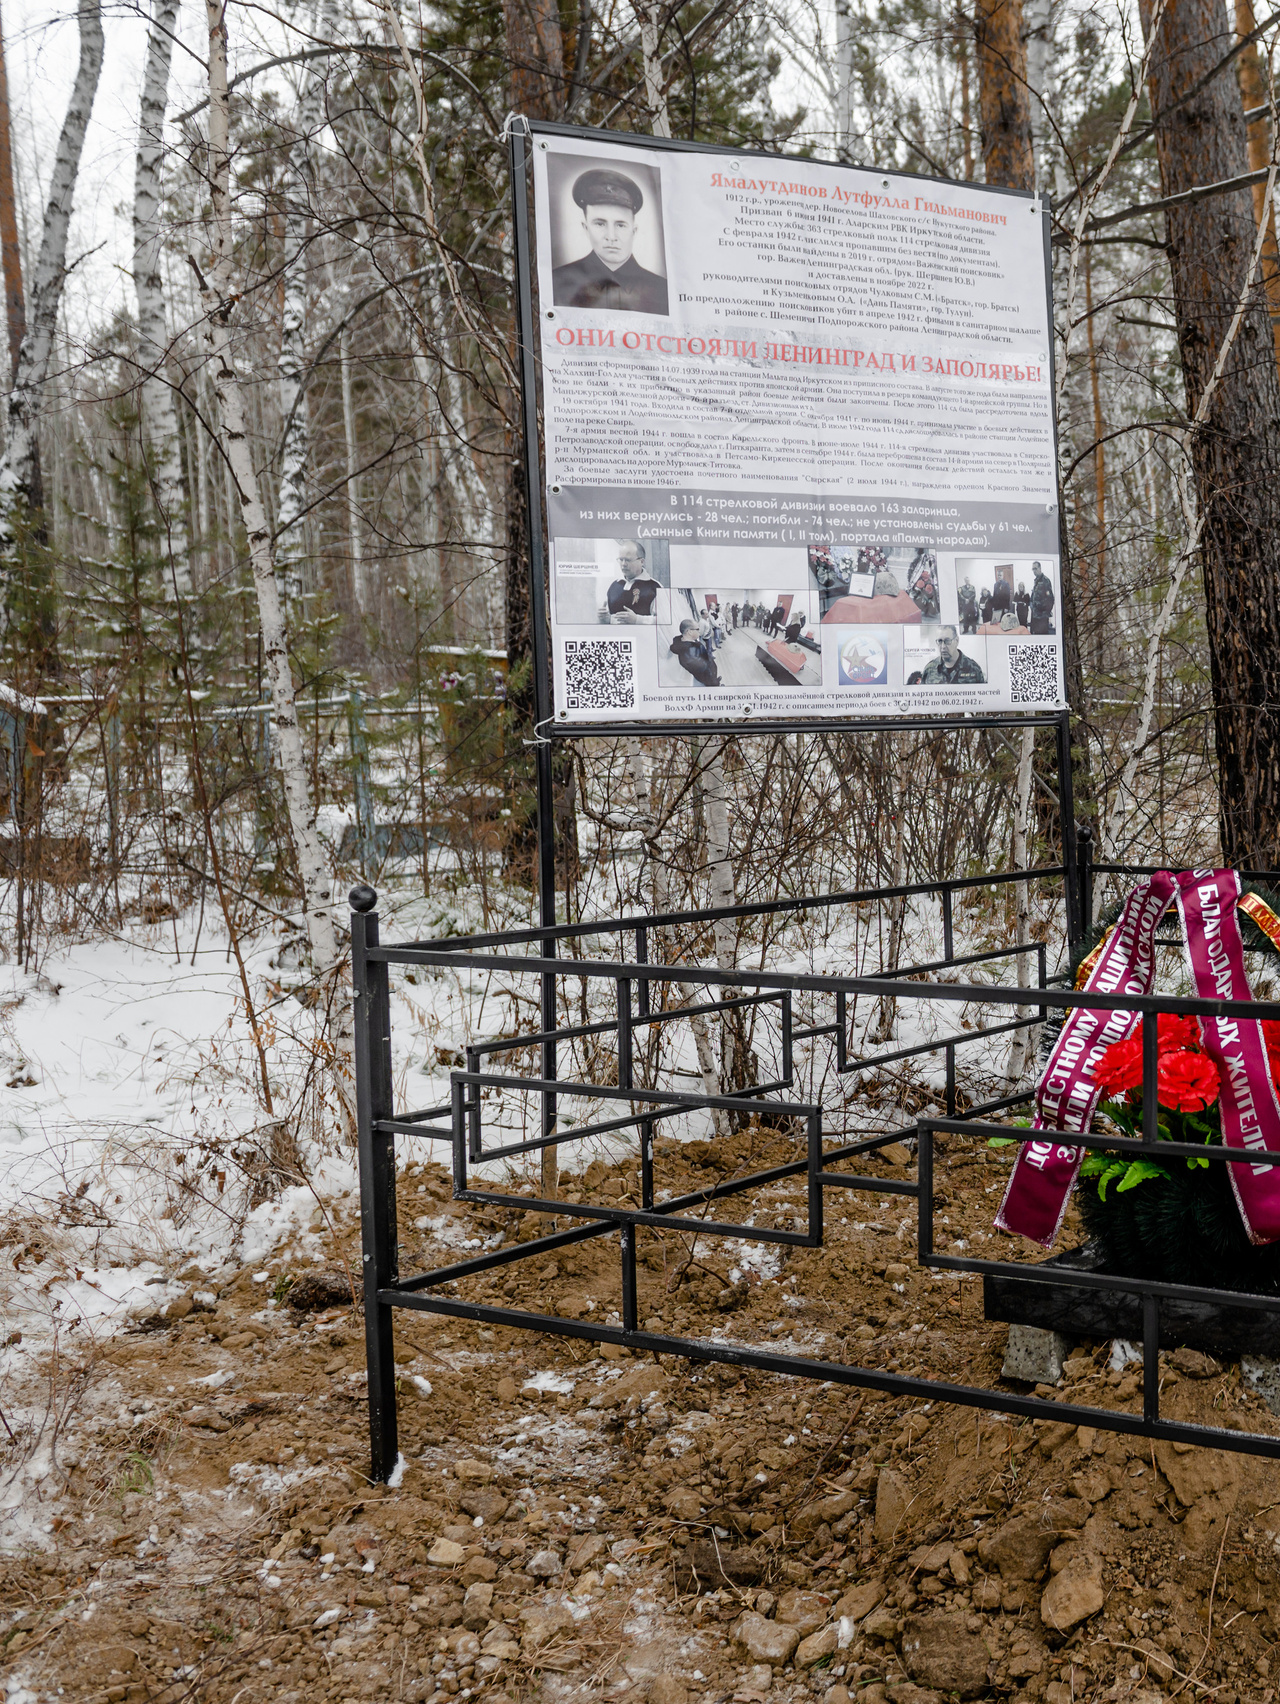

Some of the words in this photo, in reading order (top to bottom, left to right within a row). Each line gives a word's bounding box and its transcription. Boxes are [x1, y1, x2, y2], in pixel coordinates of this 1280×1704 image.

[711, 173, 827, 197] Ямалутдинов
[831, 186, 908, 209] Лутфулла
[915, 197, 1006, 225] Гильманович
[725, 193, 743, 202] 1912
[734, 216, 764, 226] Место
[807, 224, 821, 232] 363
[823, 228, 874, 239] стрелковый
[900, 236, 913, 244] 114
[740, 205, 782, 216] Призван
[818, 214, 834, 223] 1941
[845, 218, 888, 230] Аларским
[891, 223, 907, 232] РВК
[718, 238, 734, 246] Его
[736, 241, 775, 249] останки
[777, 242, 801, 252] были
[848, 251, 866, 260] 2019
[732, 228, 773, 238] февраля
[777, 231, 795, 240] 1942
[845, 242, 896, 253] пропавшим
[897, 246, 911, 255] без
[702, 273, 782, 284] руководителями
[832, 285, 867, 294] отрядов
[869, 287, 912, 298] Чулковым
[815, 272, 867, 283] доставлены
[876, 278, 905, 288] ноябре
[907, 280, 925, 289] 2022
[679, 293, 692, 301] По
[695, 295, 775, 306] предположению
[836, 306, 856, 315] убит
[865, 311, 894, 319] апреле
[897, 312, 914, 321] 1942
[725, 309, 758, 317] районе
[889, 324, 918, 332] района
[556, 328, 615, 347] ОНИ
[622, 331, 757, 358] ОТСТОЯЛИ
[763, 342, 895, 372] ЛЕНИНГРАД
[901, 354, 915, 370] И
[922, 356, 1040, 381] ЗАПОЛЯРЬЕ!
[670, 495, 677, 505] В
[682, 495, 702, 505] 114
[705, 498, 777, 509] стрелковой
[780, 501, 825, 511] дивизии
[828, 503, 877, 512] воевало
[881, 502, 899, 513] 163
[902, 505, 960, 516] заларинца,
[579, 510, 593, 519] из
[597, 511, 620, 520] них
[624, 512, 693, 523] вернулись
[705, 511, 718, 522] 28
[720, 514, 749, 524] чел.;
[752, 514, 800, 524] погибли
[811, 515, 822, 526] 74
[825, 518, 853, 527] чел.;
[856, 518, 870, 526] не
[872, 519, 943, 530] установлены
[946, 520, 986, 532] судьбы
[989, 523, 995, 533] у
[998, 521, 1008, 531] 61
[1012, 524, 1033, 532] чел.
[637, 525, 692, 538] (данные
[696, 526, 729, 537] Книги
[733, 530, 777, 539] памяти
[799, 530, 805, 539] II
[840, 533, 889, 543] портала
[892, 532, 934, 543] «Память
[1197, 884, 1240, 1049] БЛАГОДАРЫХ
[1057, 1081, 1095, 1163] ЗМЛИ
[1081, 895, 1163, 1076] ПОДПООЖСКОЙ
